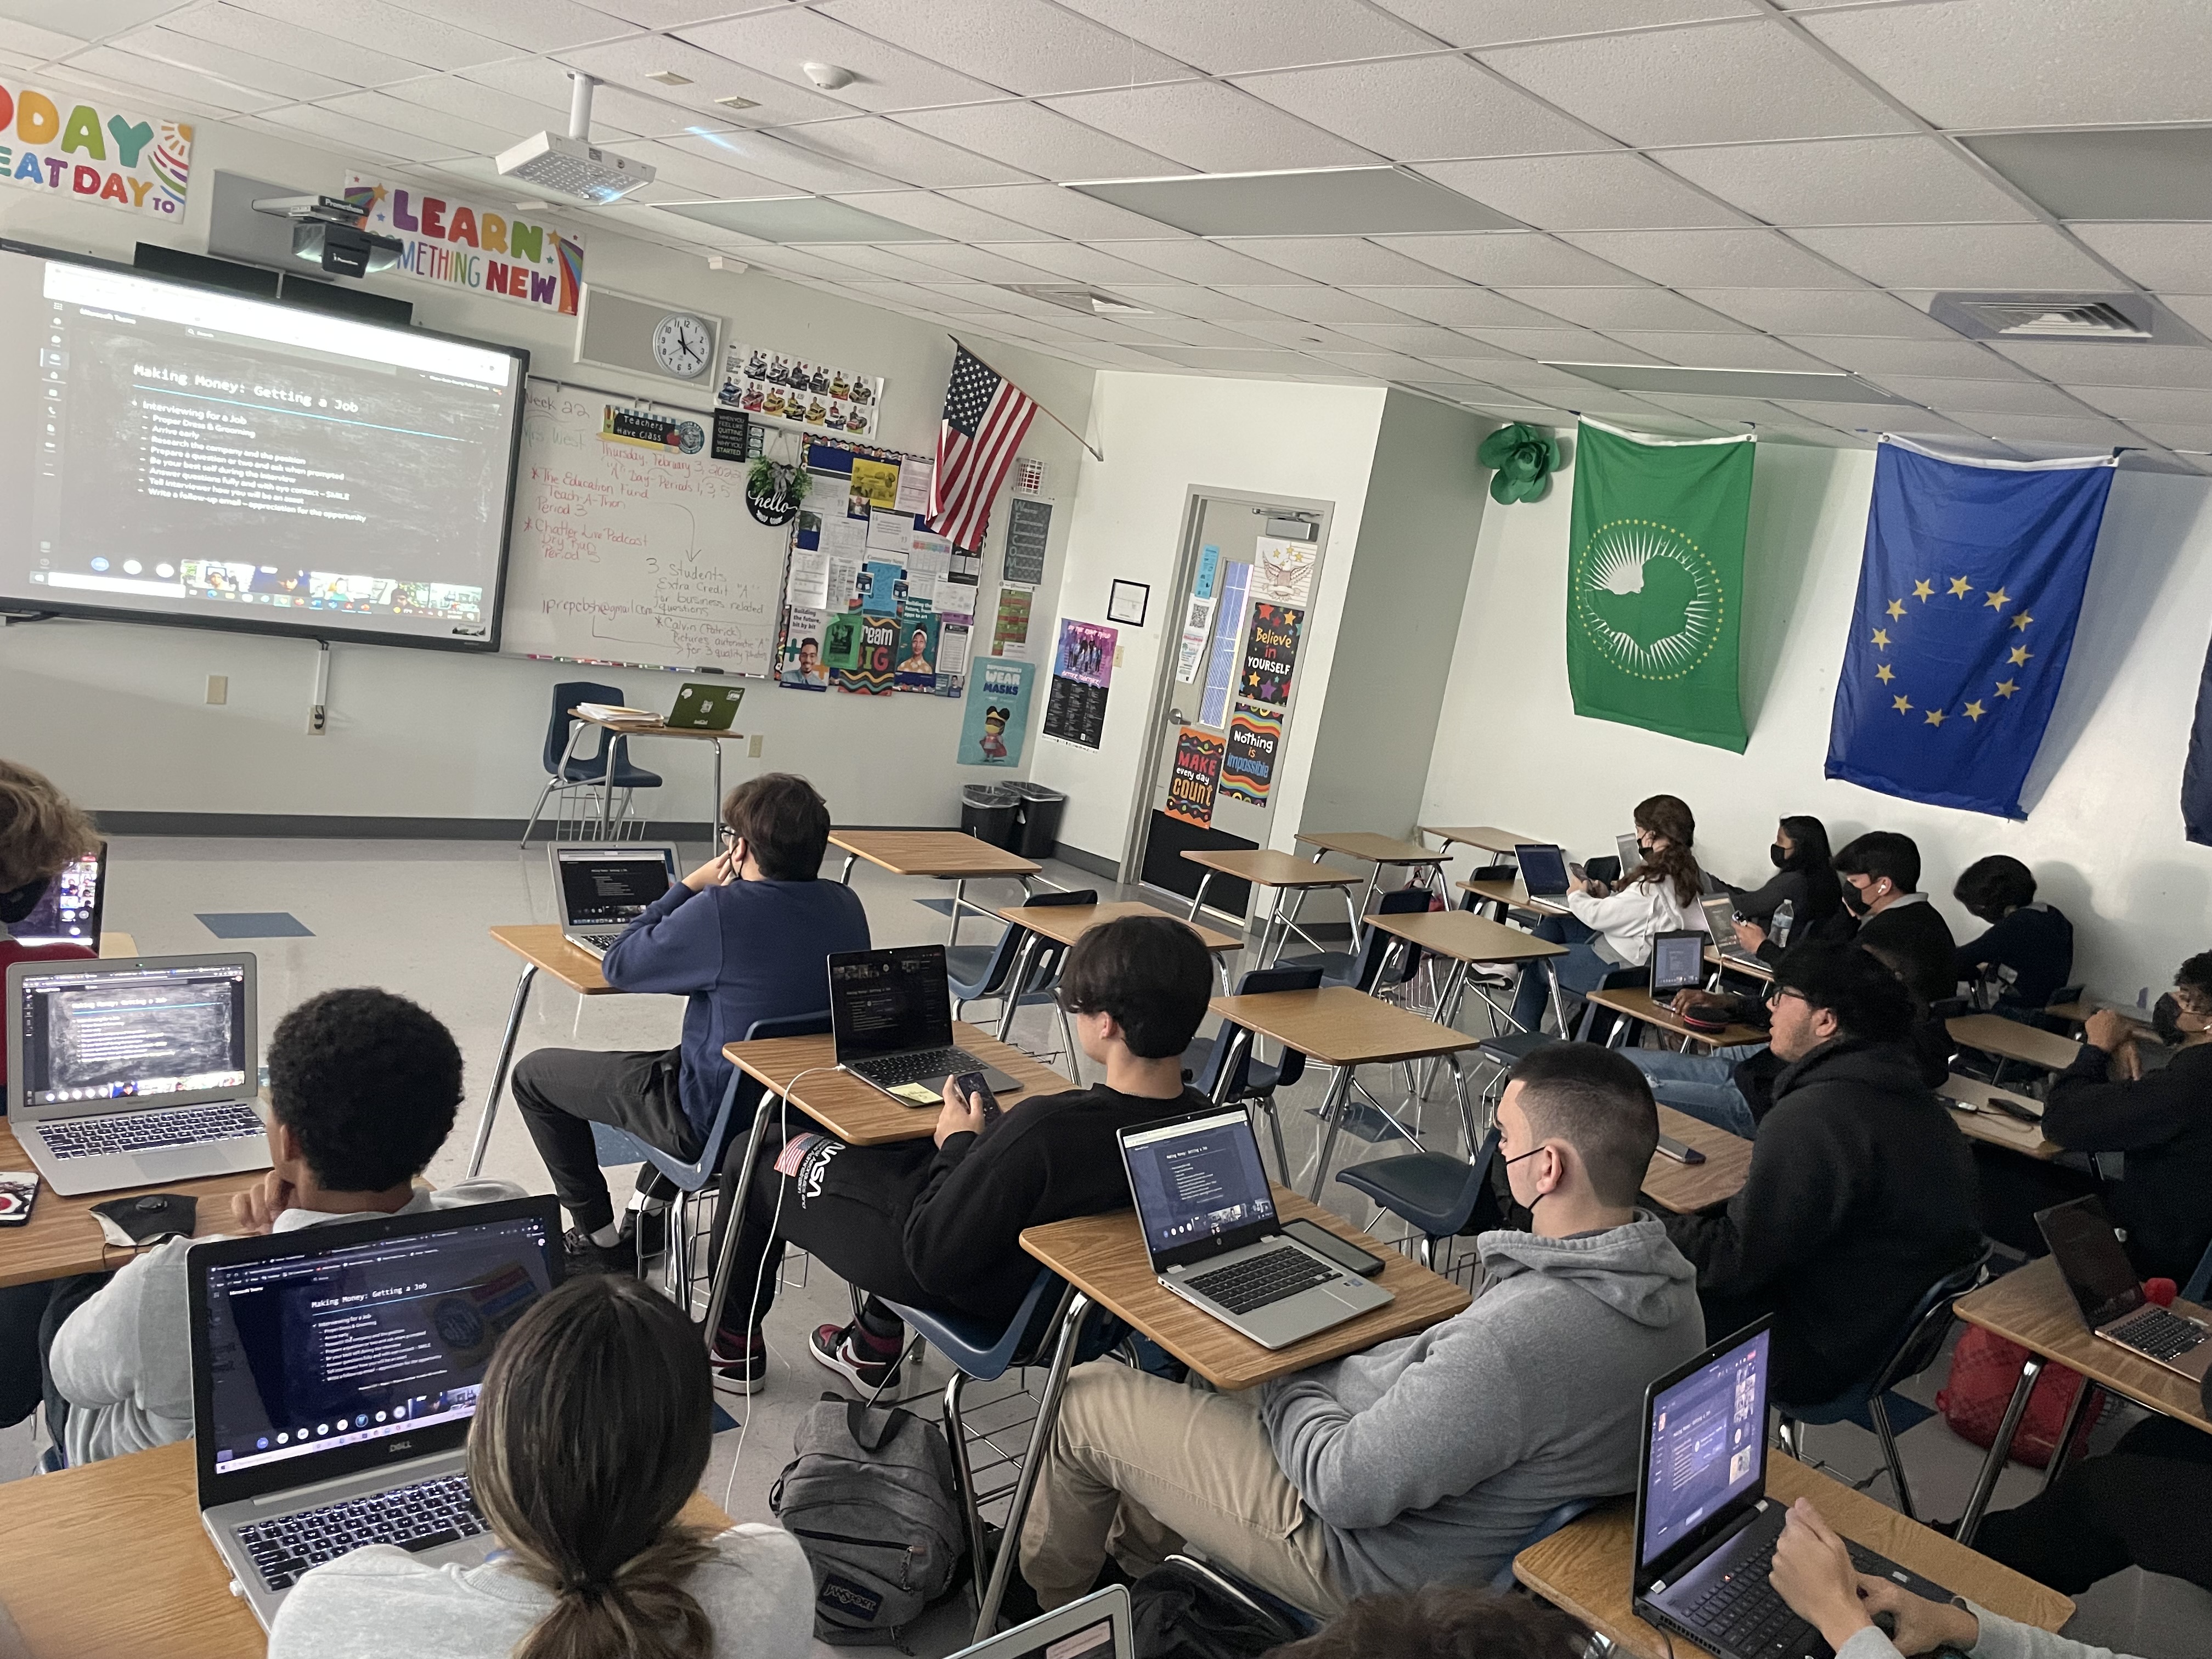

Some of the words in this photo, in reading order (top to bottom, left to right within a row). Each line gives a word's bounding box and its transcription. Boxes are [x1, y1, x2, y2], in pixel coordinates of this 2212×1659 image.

[72, 164, 154, 207] DAY
[153, 197, 175, 213] TO
[393, 189, 543, 263] LEARN
[369, 230, 481, 288] METHING
[486, 260, 556, 305] NEW
[665, 326, 672, 334] 10
[674, 319, 680, 328] 11
[684, 320, 690, 328] 12
[134, 364, 188, 386] Making
[195, 375, 245, 394] Money:
[253, 386, 312, 407] Getting
[318, 399, 328, 408] a
[334, 400, 359, 413] Job
[143, 400, 205, 420] Interviewing
[206, 410, 221, 420] for
[229, 415, 247, 425] Job
[624, 415, 663, 431] Teachers
[617, 427, 635, 438] Have
[639, 431, 662, 442] Class
[654, 453, 691, 478] February
[620, 483, 649, 499] Fund
[748, 490, 799, 514] hello
[646, 557, 659, 574] 3
[669, 560, 727, 582] Students
[657, 577, 690, 590] Extra
[696, 582, 728, 596] Credit
[677, 592, 725, 608] business
[794, 608, 816, 617] Building
[860, 624, 893, 646] ream
[1256, 627, 1292, 648] Believe
[1265, 645, 1277, 659] in
[1248, 656, 1291, 675] YOURSELF
[985, 670, 1020, 685] WEAR
[983, 682, 1019, 696] MASKS
[1234, 730, 1274, 754] Nothing
[1248, 747, 1256, 758] is
[1178, 751, 1217, 777] MAKE
[1176, 766, 1194, 781] every
[1196, 772, 1210, 785] day
[806, 1142, 846, 1198] NASA
[311, 1298, 339, 1308] Making
[342, 1293, 368, 1304] Money:
[372, 1287, 403, 1298] Getting
[823, 1584, 877, 1611] JANSPORT
